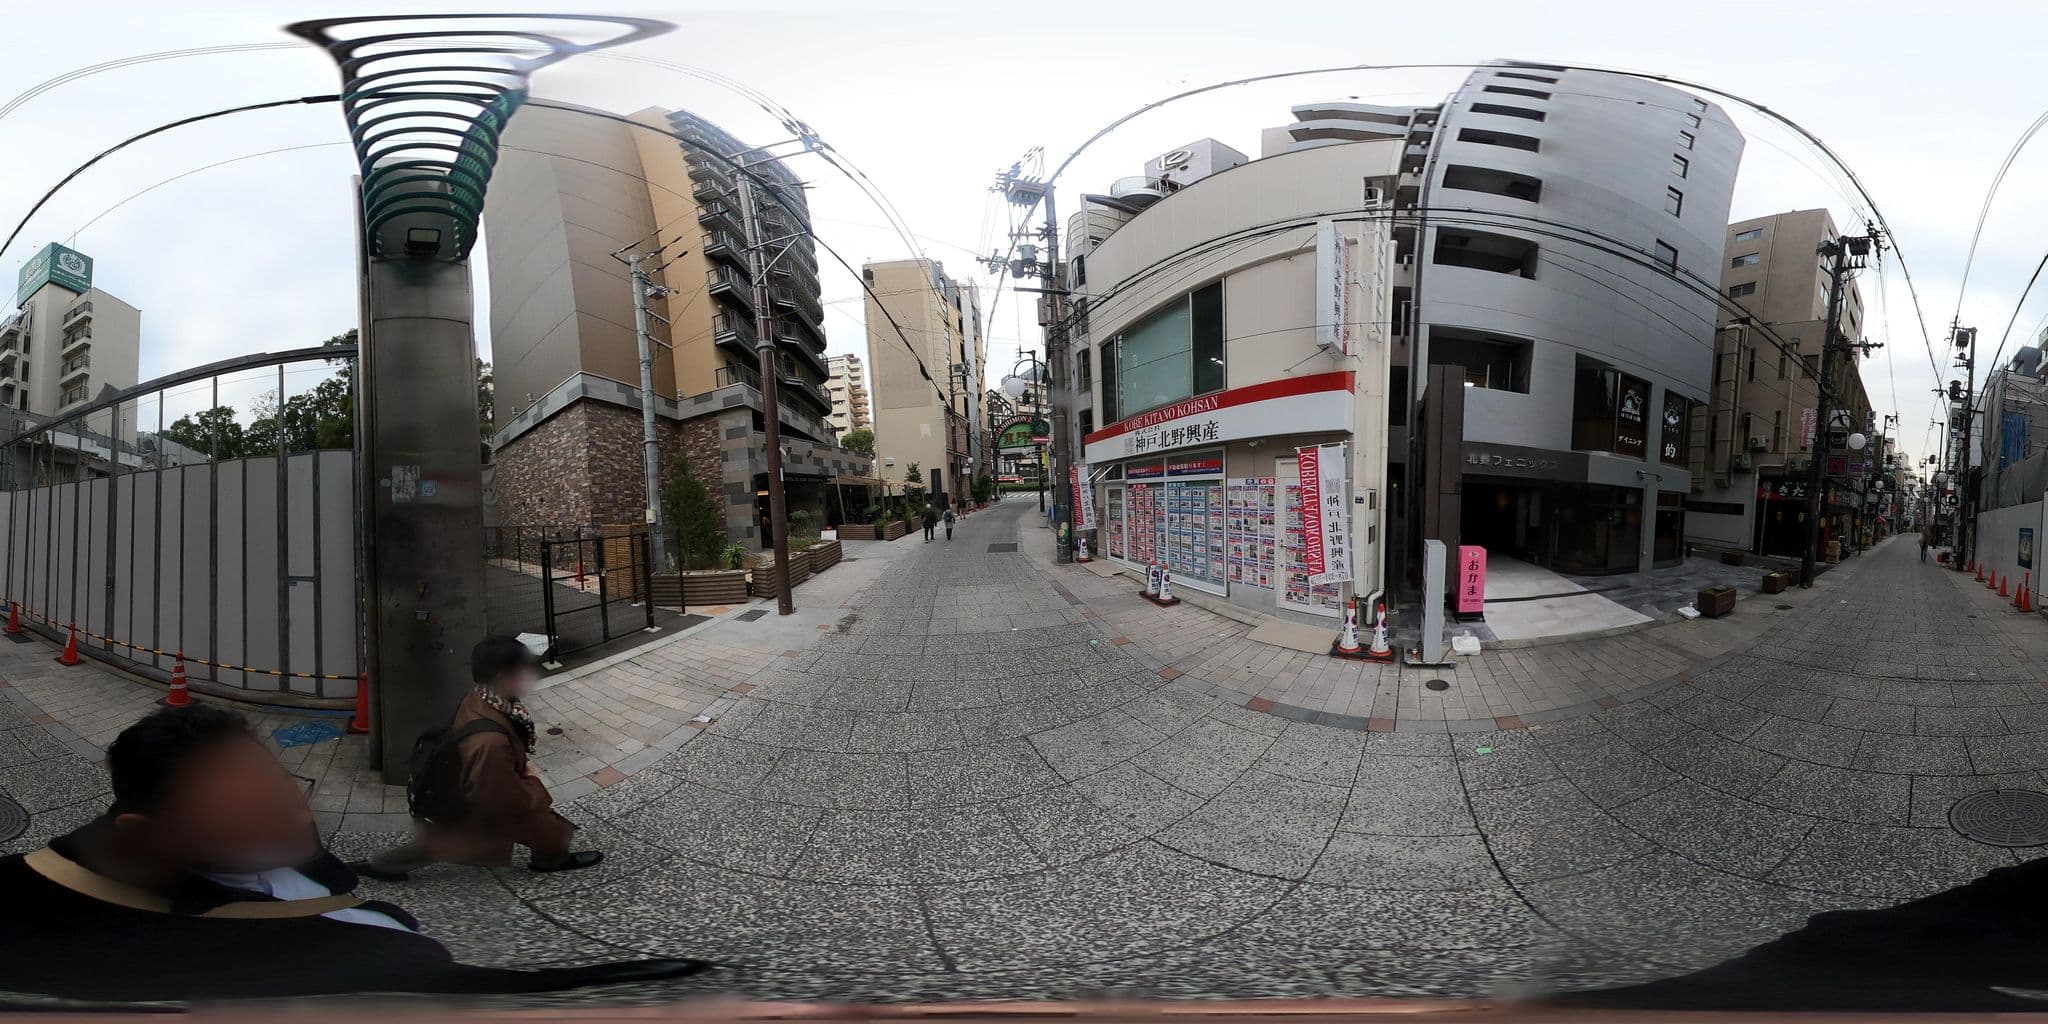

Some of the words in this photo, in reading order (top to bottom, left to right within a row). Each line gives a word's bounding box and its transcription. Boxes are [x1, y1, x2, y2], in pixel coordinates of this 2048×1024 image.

[1124, 418, 1143, 432] KOBE
[1144, 407, 1175, 427] KITANO
[1177, 396, 1219, 418] KOHSAN
[1135, 420, 1219, 454] 神戸北野興産
[1467, 560, 1479, 596] おかま
